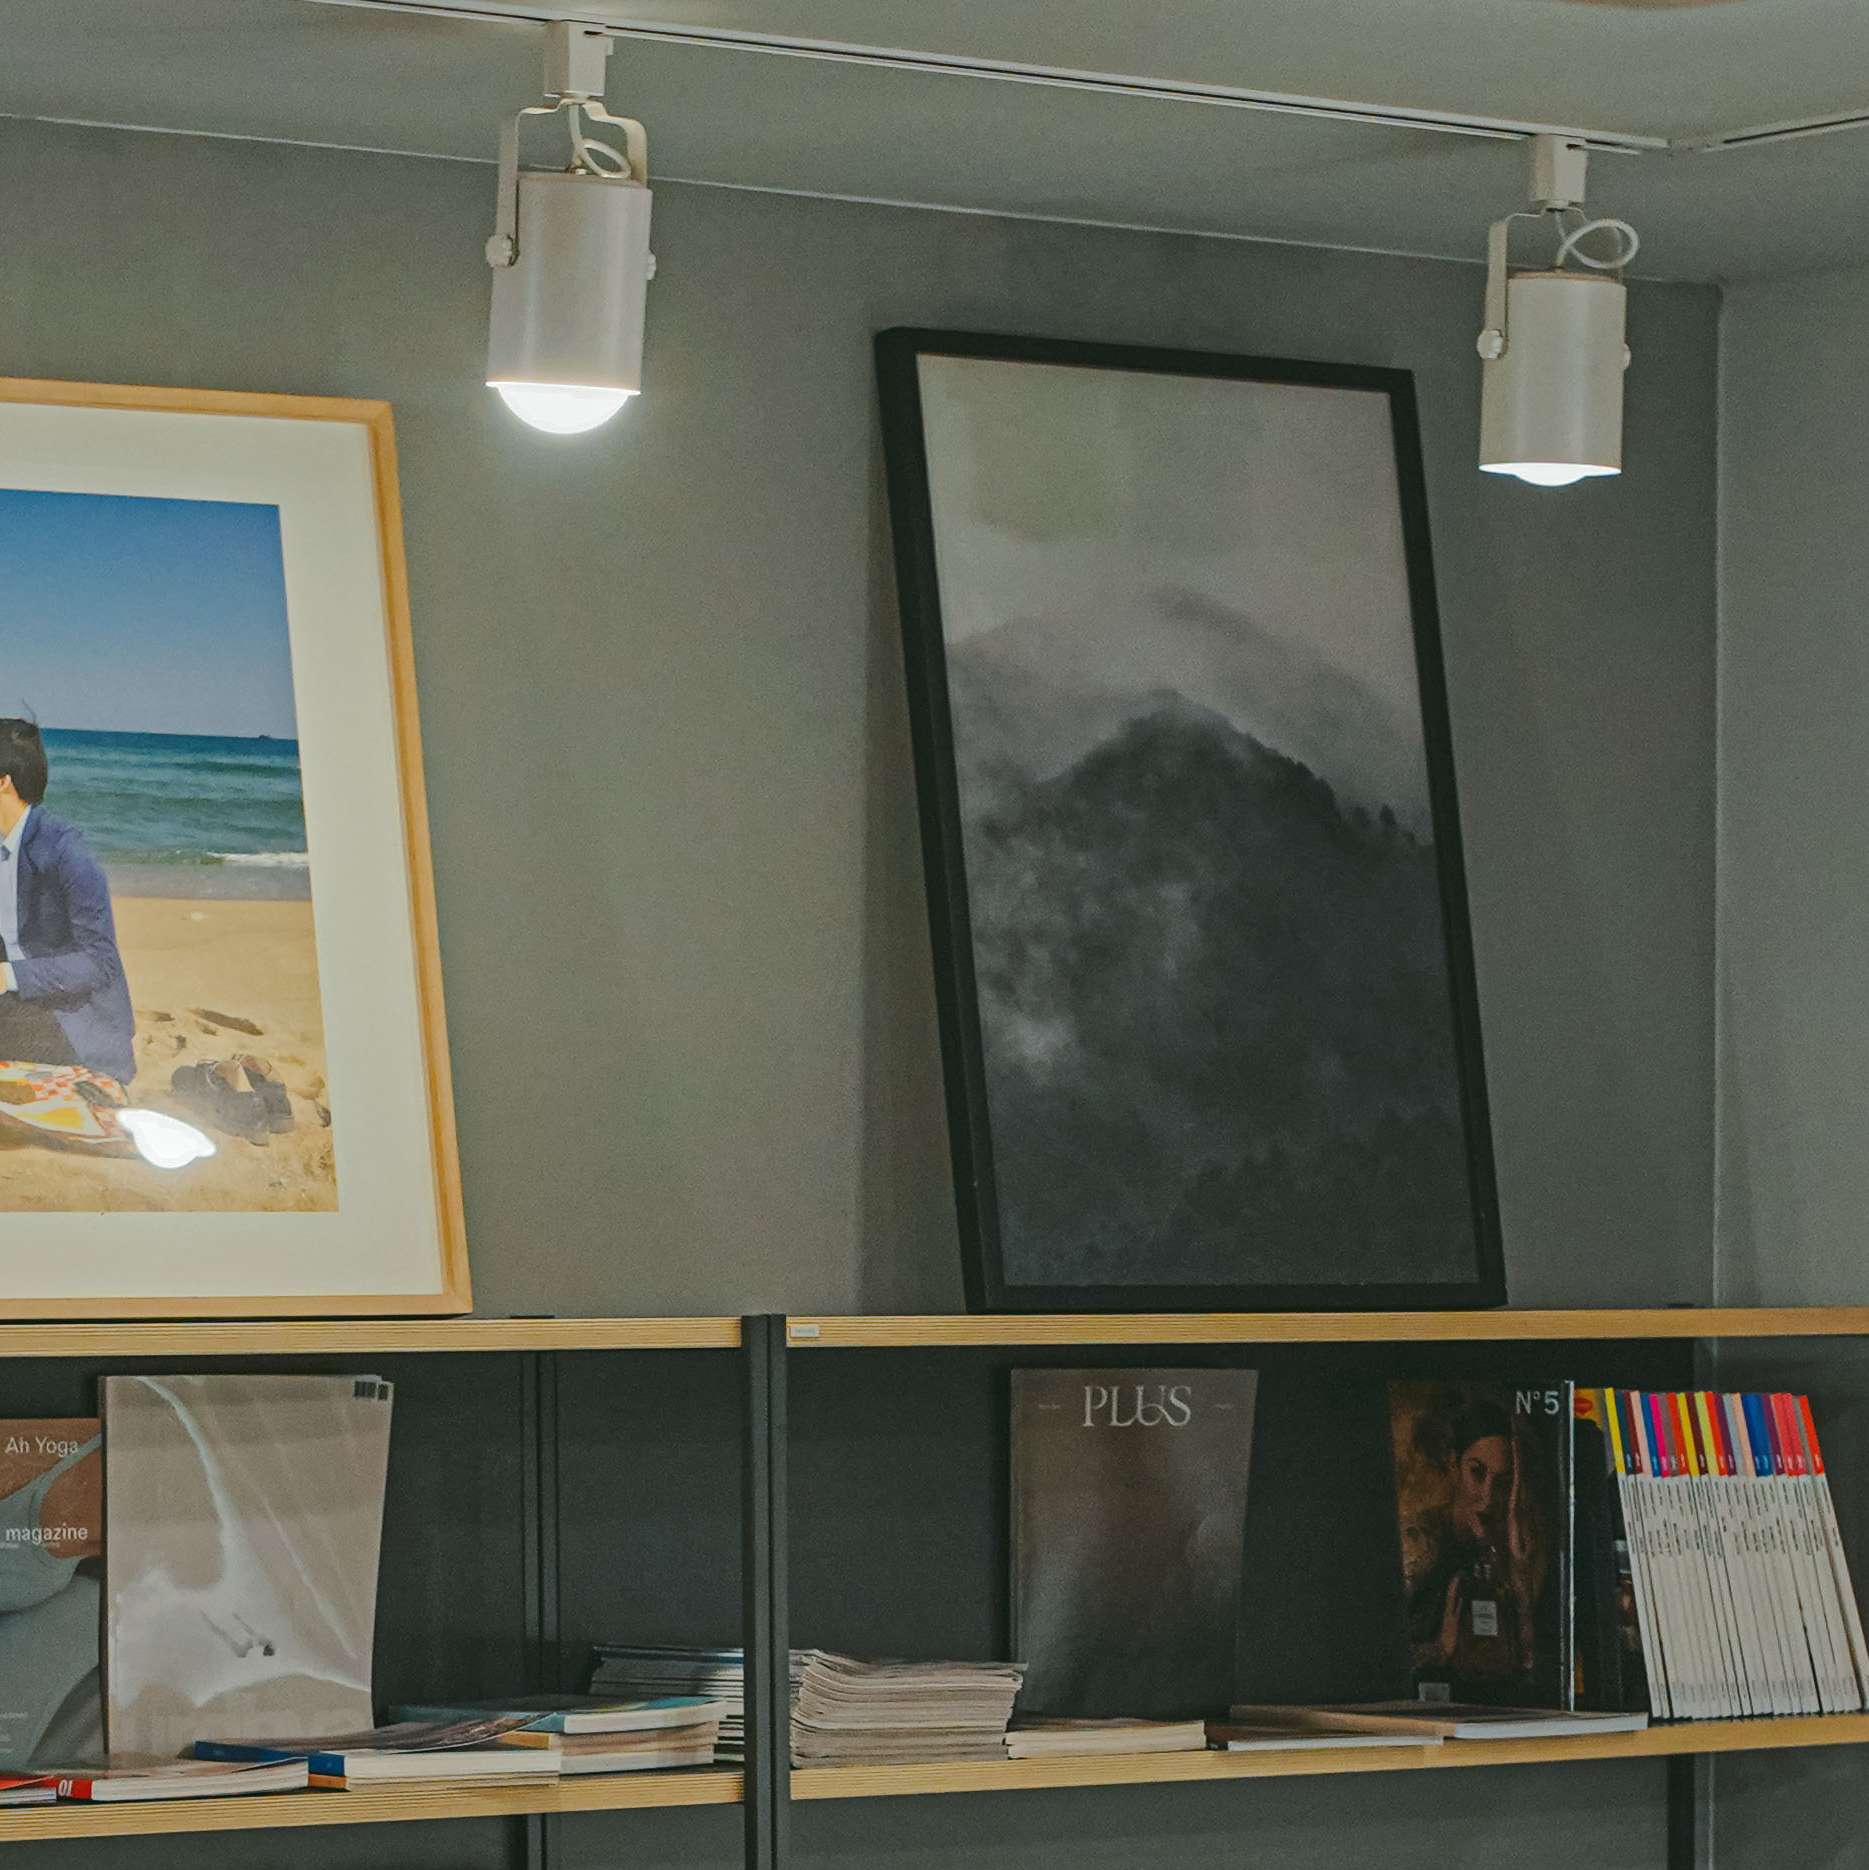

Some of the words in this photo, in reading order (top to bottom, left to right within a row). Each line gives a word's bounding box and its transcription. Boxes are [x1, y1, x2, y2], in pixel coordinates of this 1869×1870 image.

[1082, 1384, 1193, 1428] PLUS
[5, 1435, 30, 1453] Ah
[35, 1435, 79, 1458] Yoga
[5, 1522, 89, 1546] magazine
